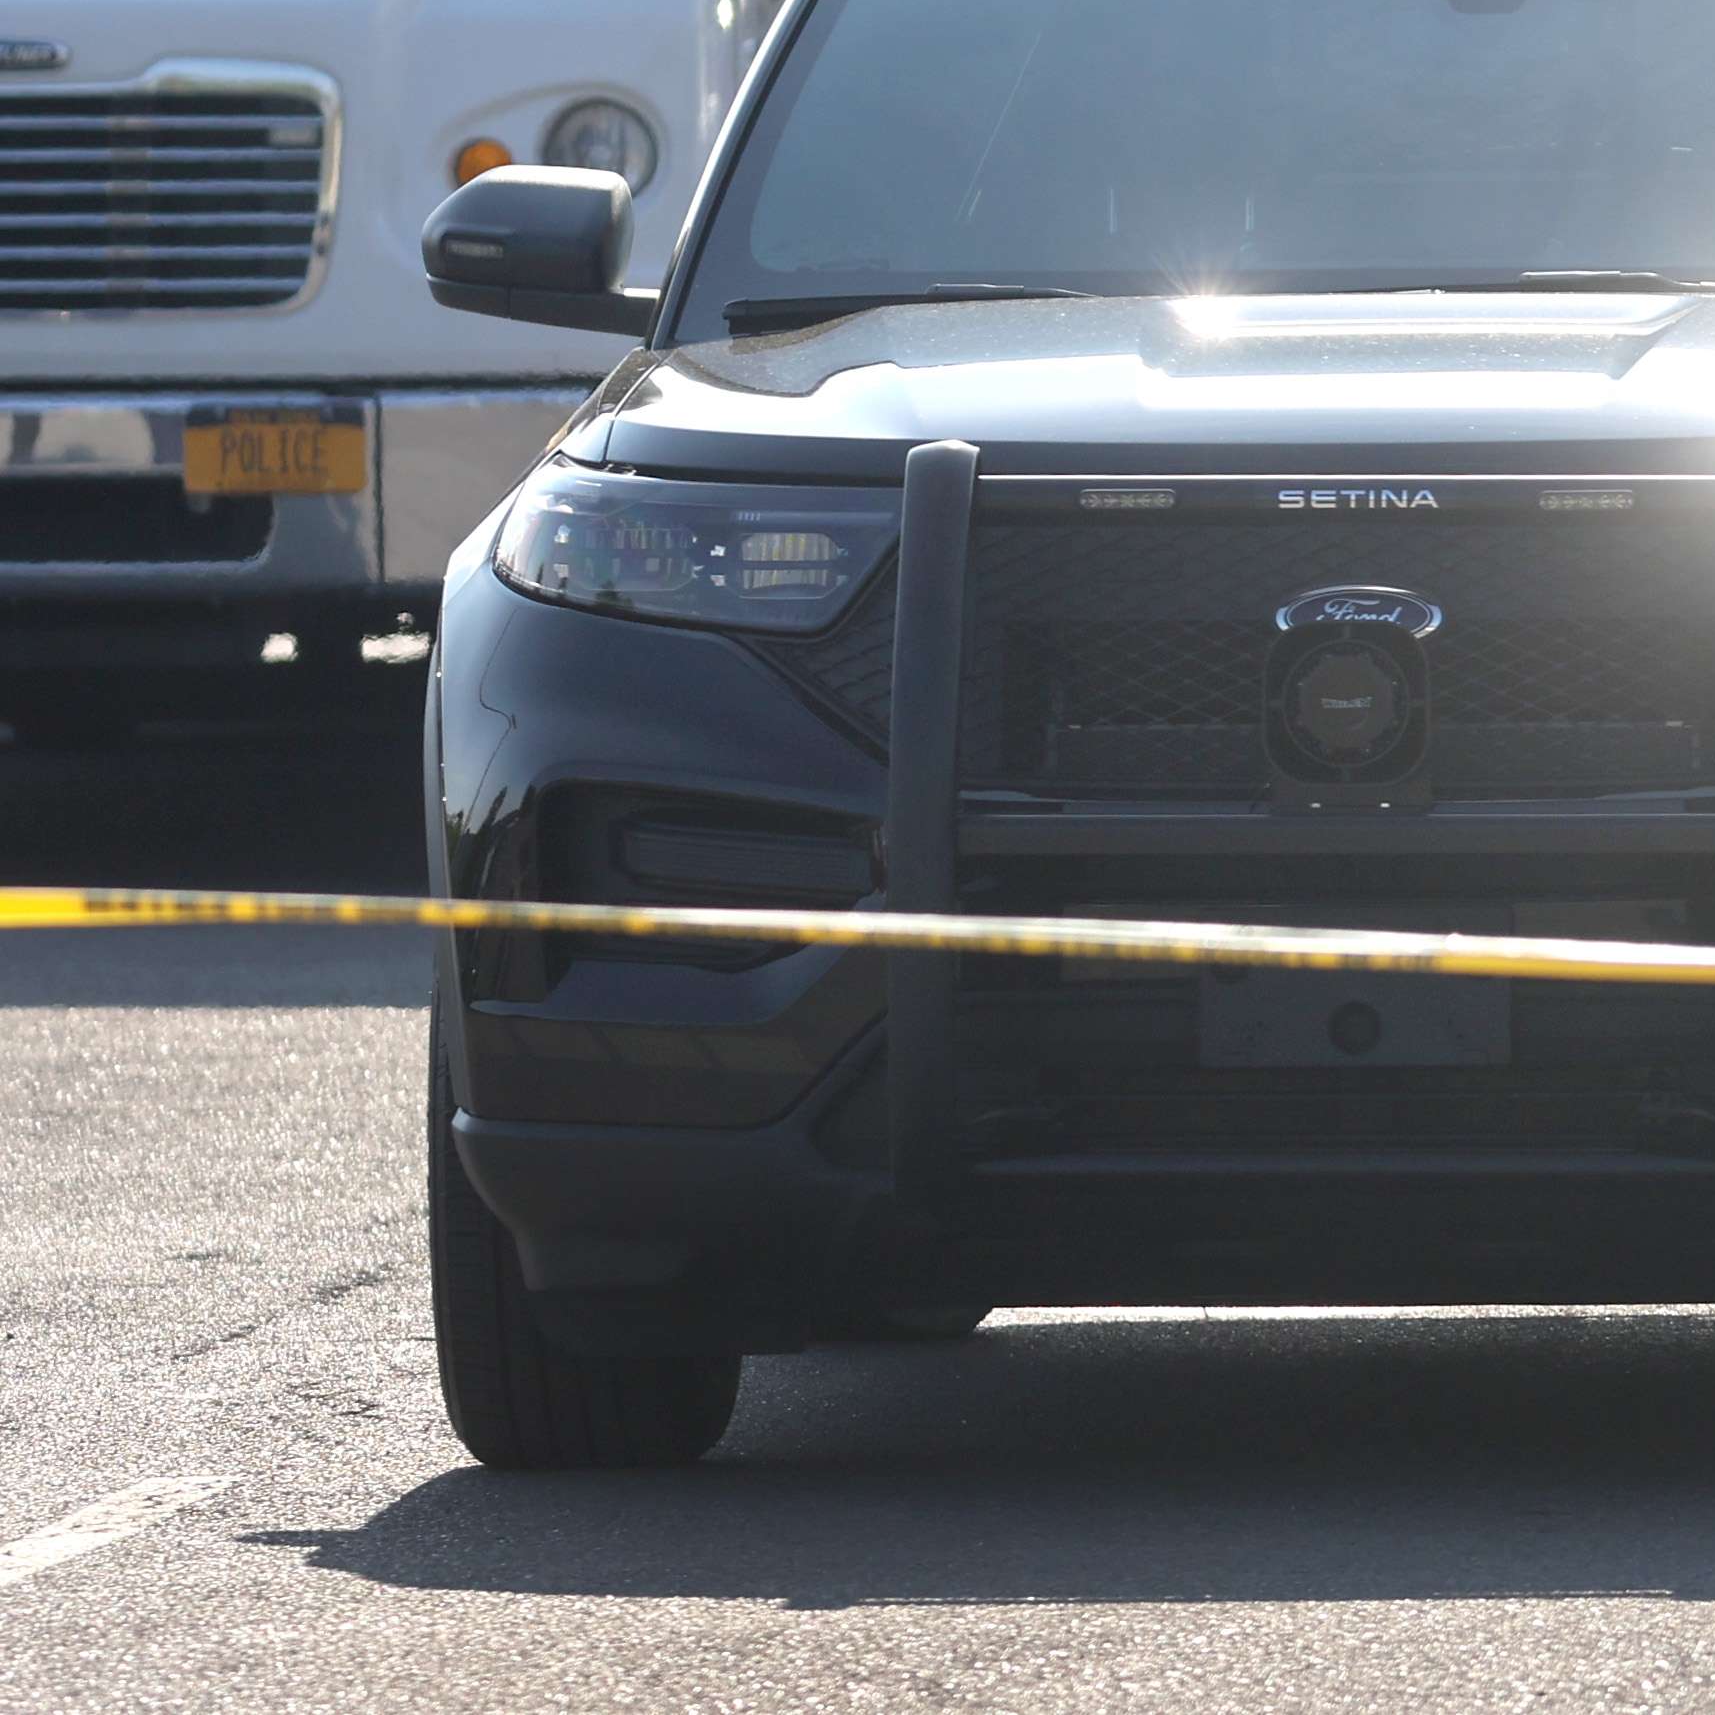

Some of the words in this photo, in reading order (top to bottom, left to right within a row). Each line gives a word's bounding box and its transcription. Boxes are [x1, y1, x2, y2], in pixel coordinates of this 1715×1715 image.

[220, 428, 329, 474] POLICE
[1278, 489, 1439, 509] SETINA
[1316, 598, 1402, 623] Ford
